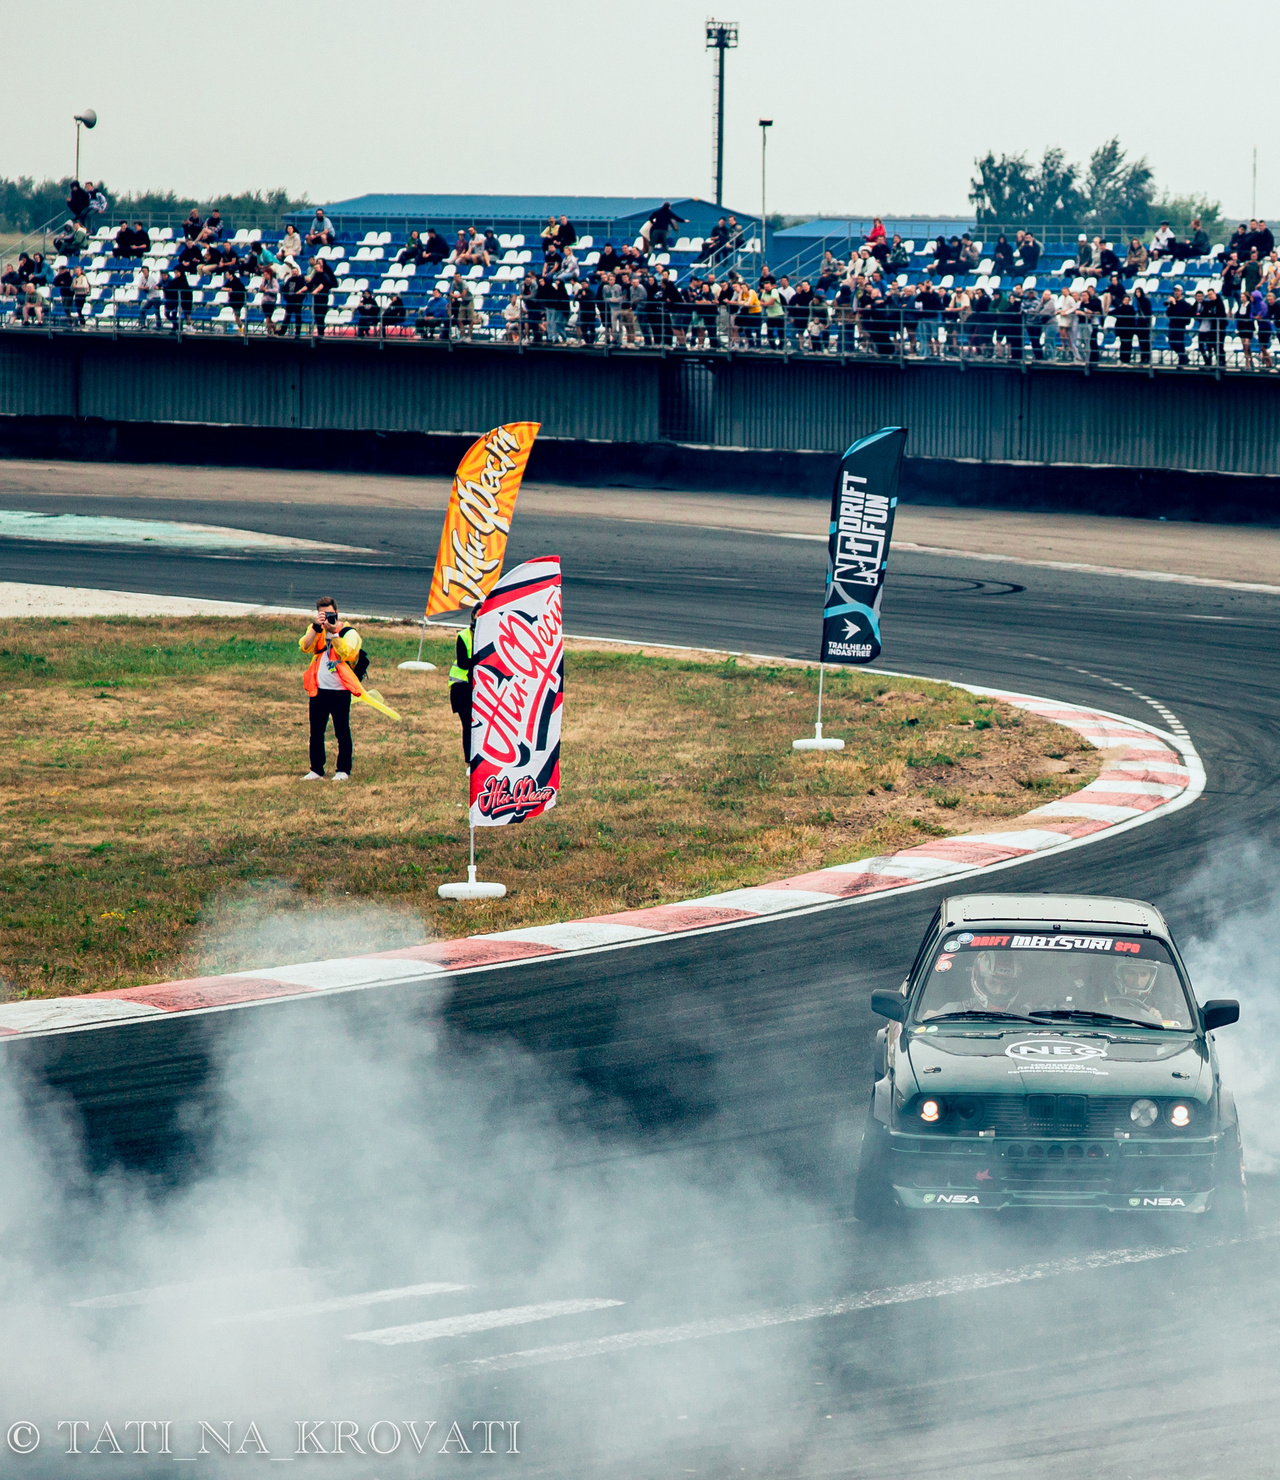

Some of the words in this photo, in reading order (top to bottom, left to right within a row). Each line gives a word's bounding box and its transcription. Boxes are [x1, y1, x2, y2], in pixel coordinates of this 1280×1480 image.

[838, 470, 868, 532] DRIFT
[861, 493, 889, 536] FUN
[828, 641, 872, 651] TRAILHEAD
[828, 648, 871, 657] INDASTREE
[970, 935, 1010, 947] DRIFT
[1010, 935, 1113, 950] MATSURI
[1114, 941, 1141, 954] SPB
[937, 1194, 980, 1204] NSA
[1143, 1197, 1186, 1206] NSA
